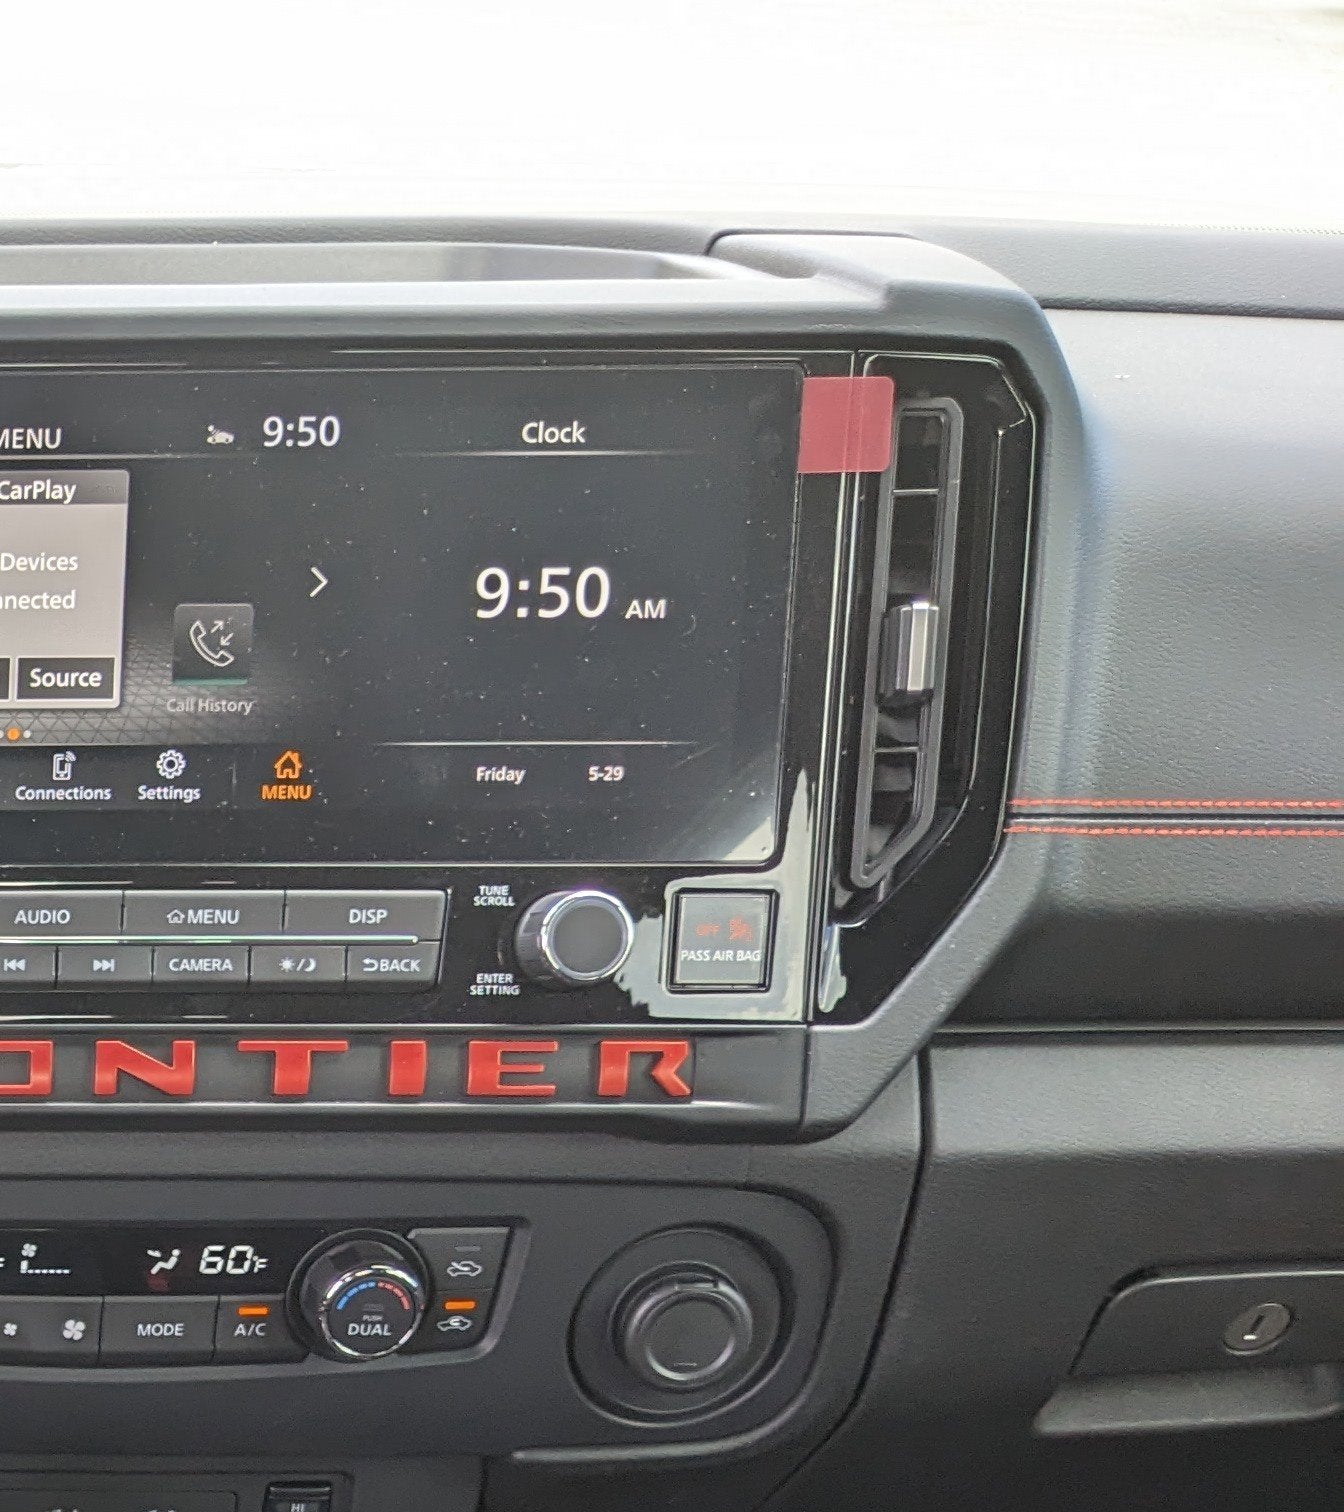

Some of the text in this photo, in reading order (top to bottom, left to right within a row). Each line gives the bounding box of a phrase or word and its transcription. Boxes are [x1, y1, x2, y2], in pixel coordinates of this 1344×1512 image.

[263, 415, 341, 449] 9:50
[521, 420, 586, 445] Clock
[0, 551, 79, 572] Devices
[475, 566, 668, 621] 9:50 AM
[29, 667, 102, 689] Source
[165, 698, 254, 716] Call History
[476, 765, 527, 786] Friday
[587, 766, 625, 782] 5-29
[15, 785, 112, 802] Connections
[137, 784, 201, 803] Settings
[261, 783, 312, 801] MENU
[479, 885, 510, 896] TUNE
[473, 896, 515, 908] SCROLL
[14, 909, 71, 926] AUDIO
[187, 909, 240, 926] MENU
[349, 909, 388, 925] DISP
[680, 949, 762, 962] PASS AIR BAG
[169, 958, 233, 974] CAMERA
[380, 958, 421, 974] BACK
[476, 973, 514, 985] ENTER
[469, 984, 520, 997] SETTING
[136, 1323, 186, 1338] MODE
[233, 1322, 267, 1337] A/C
[347, 1323, 392, 1337] DUAL
[290, 1503, 305, 1512] HI
